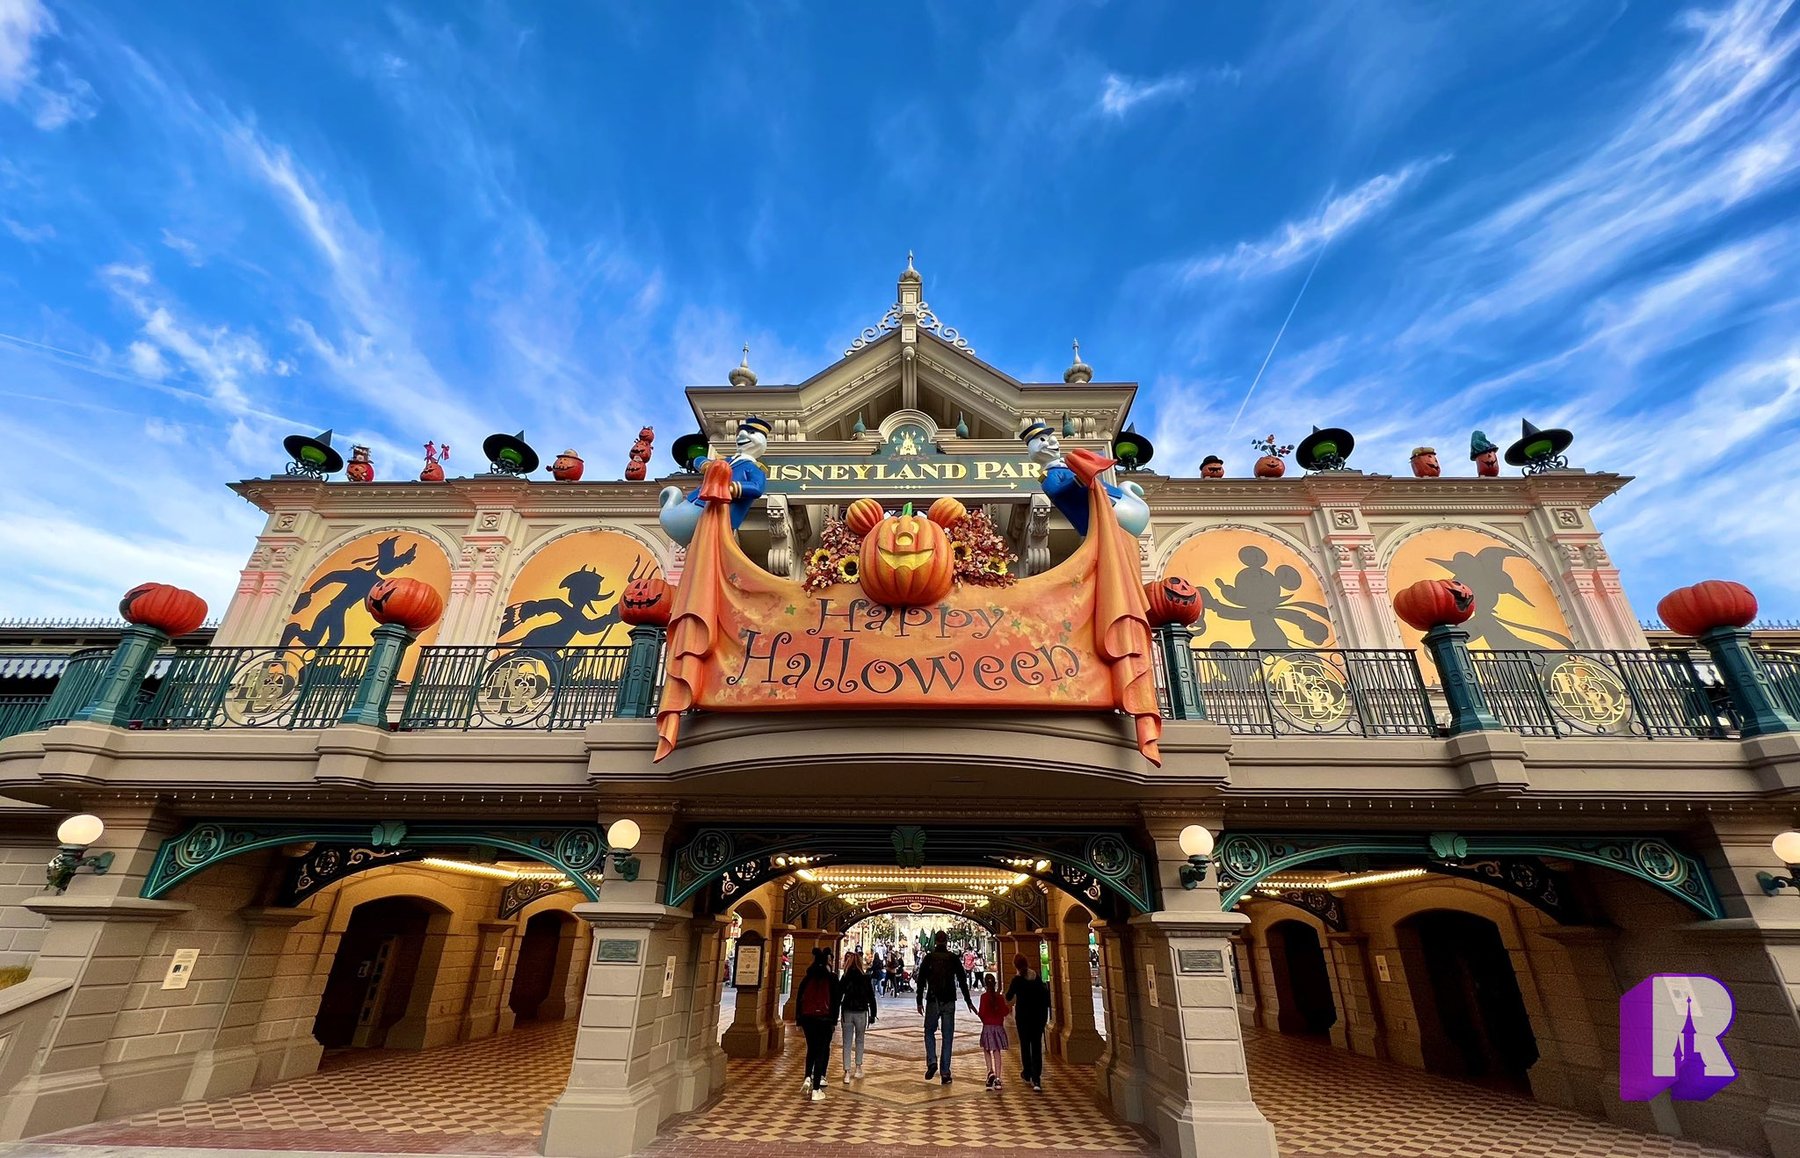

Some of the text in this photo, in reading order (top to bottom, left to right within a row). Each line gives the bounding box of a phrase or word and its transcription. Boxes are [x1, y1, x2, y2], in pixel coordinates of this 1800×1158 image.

[766, 461, 1042, 481] ISNEYLAND PAR
[806, 597, 1005, 640] Happy
[726, 629, 1081, 695] Halloween
